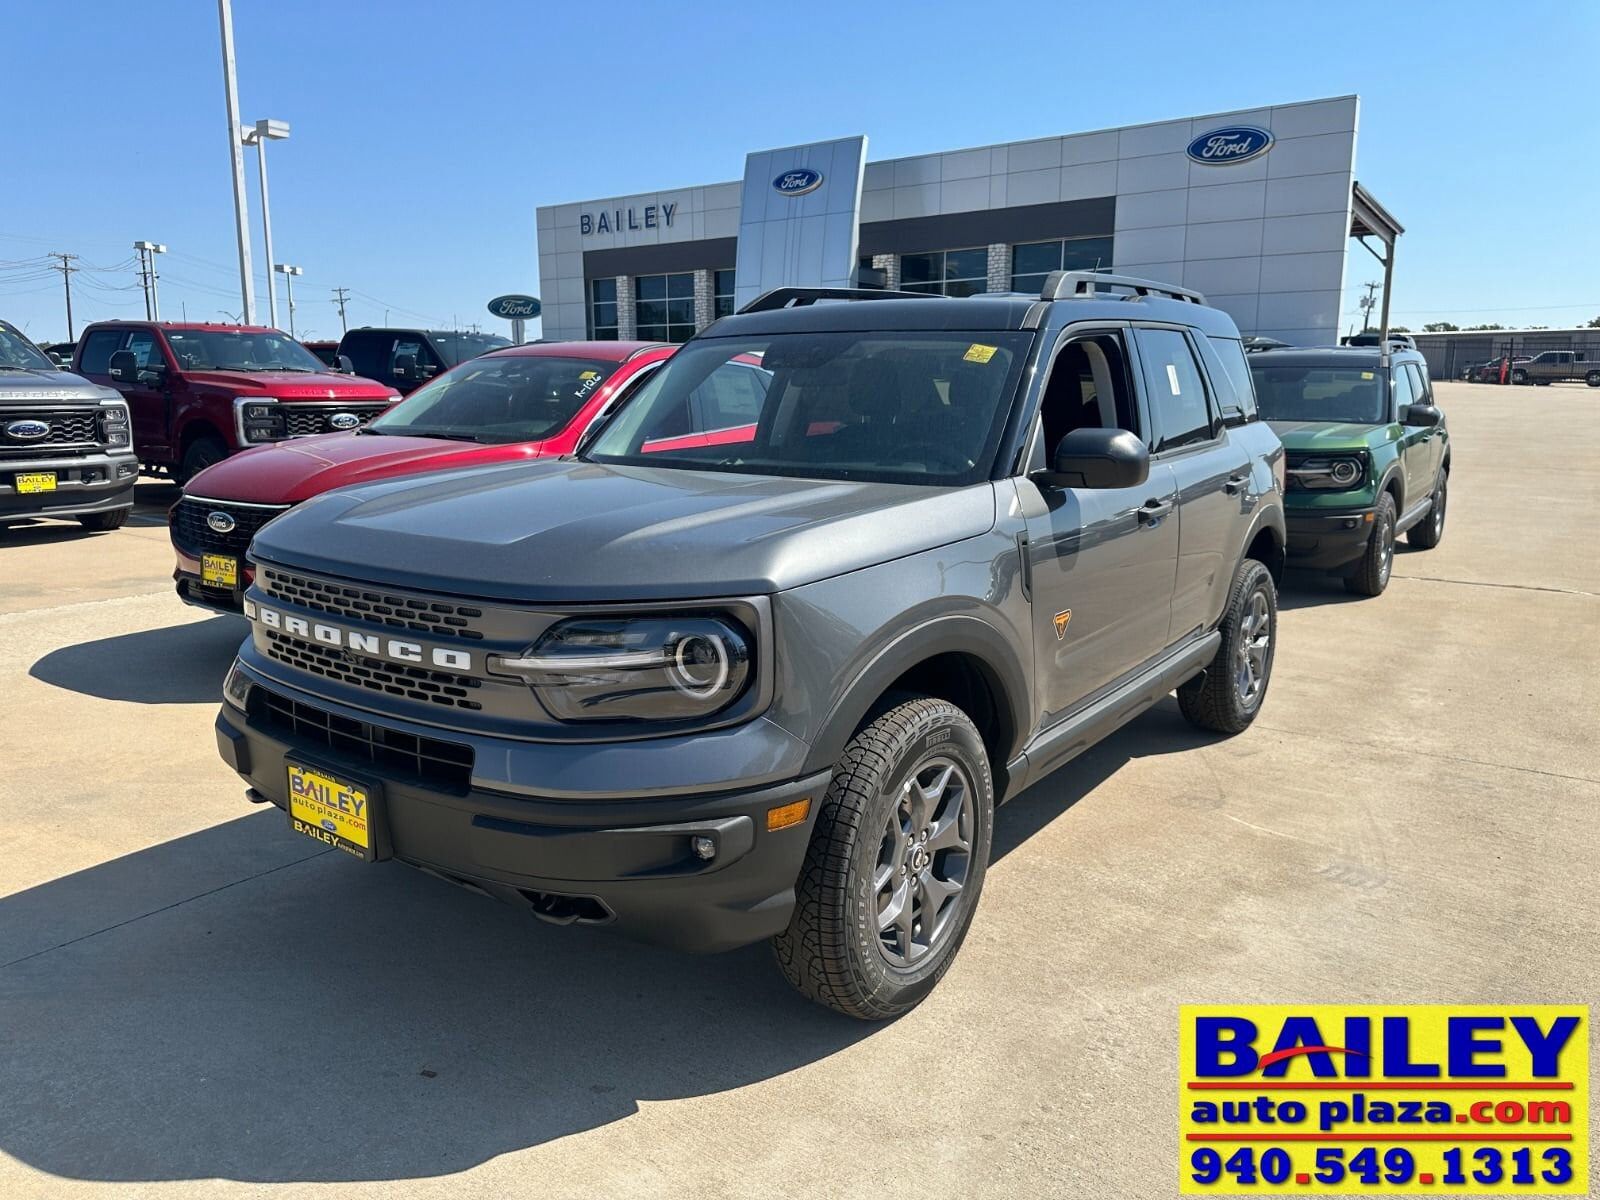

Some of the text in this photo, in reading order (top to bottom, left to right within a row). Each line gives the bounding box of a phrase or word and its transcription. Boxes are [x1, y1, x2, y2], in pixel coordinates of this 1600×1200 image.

[1202, 134, 1252, 158] Ford
[781, 173, 809, 189] Ford
[580, 204, 675, 235] BAILEY
[499, 300, 534, 314] Ford
[18, 476, 54, 484] BAILEY
[204, 560, 236, 571] BAILEY
[260, 607, 471, 671] BRONCO
[291, 774, 364, 816] BAILEY
[293, 796, 315, 811] auto
[294, 820, 339, 847] BAILEY
